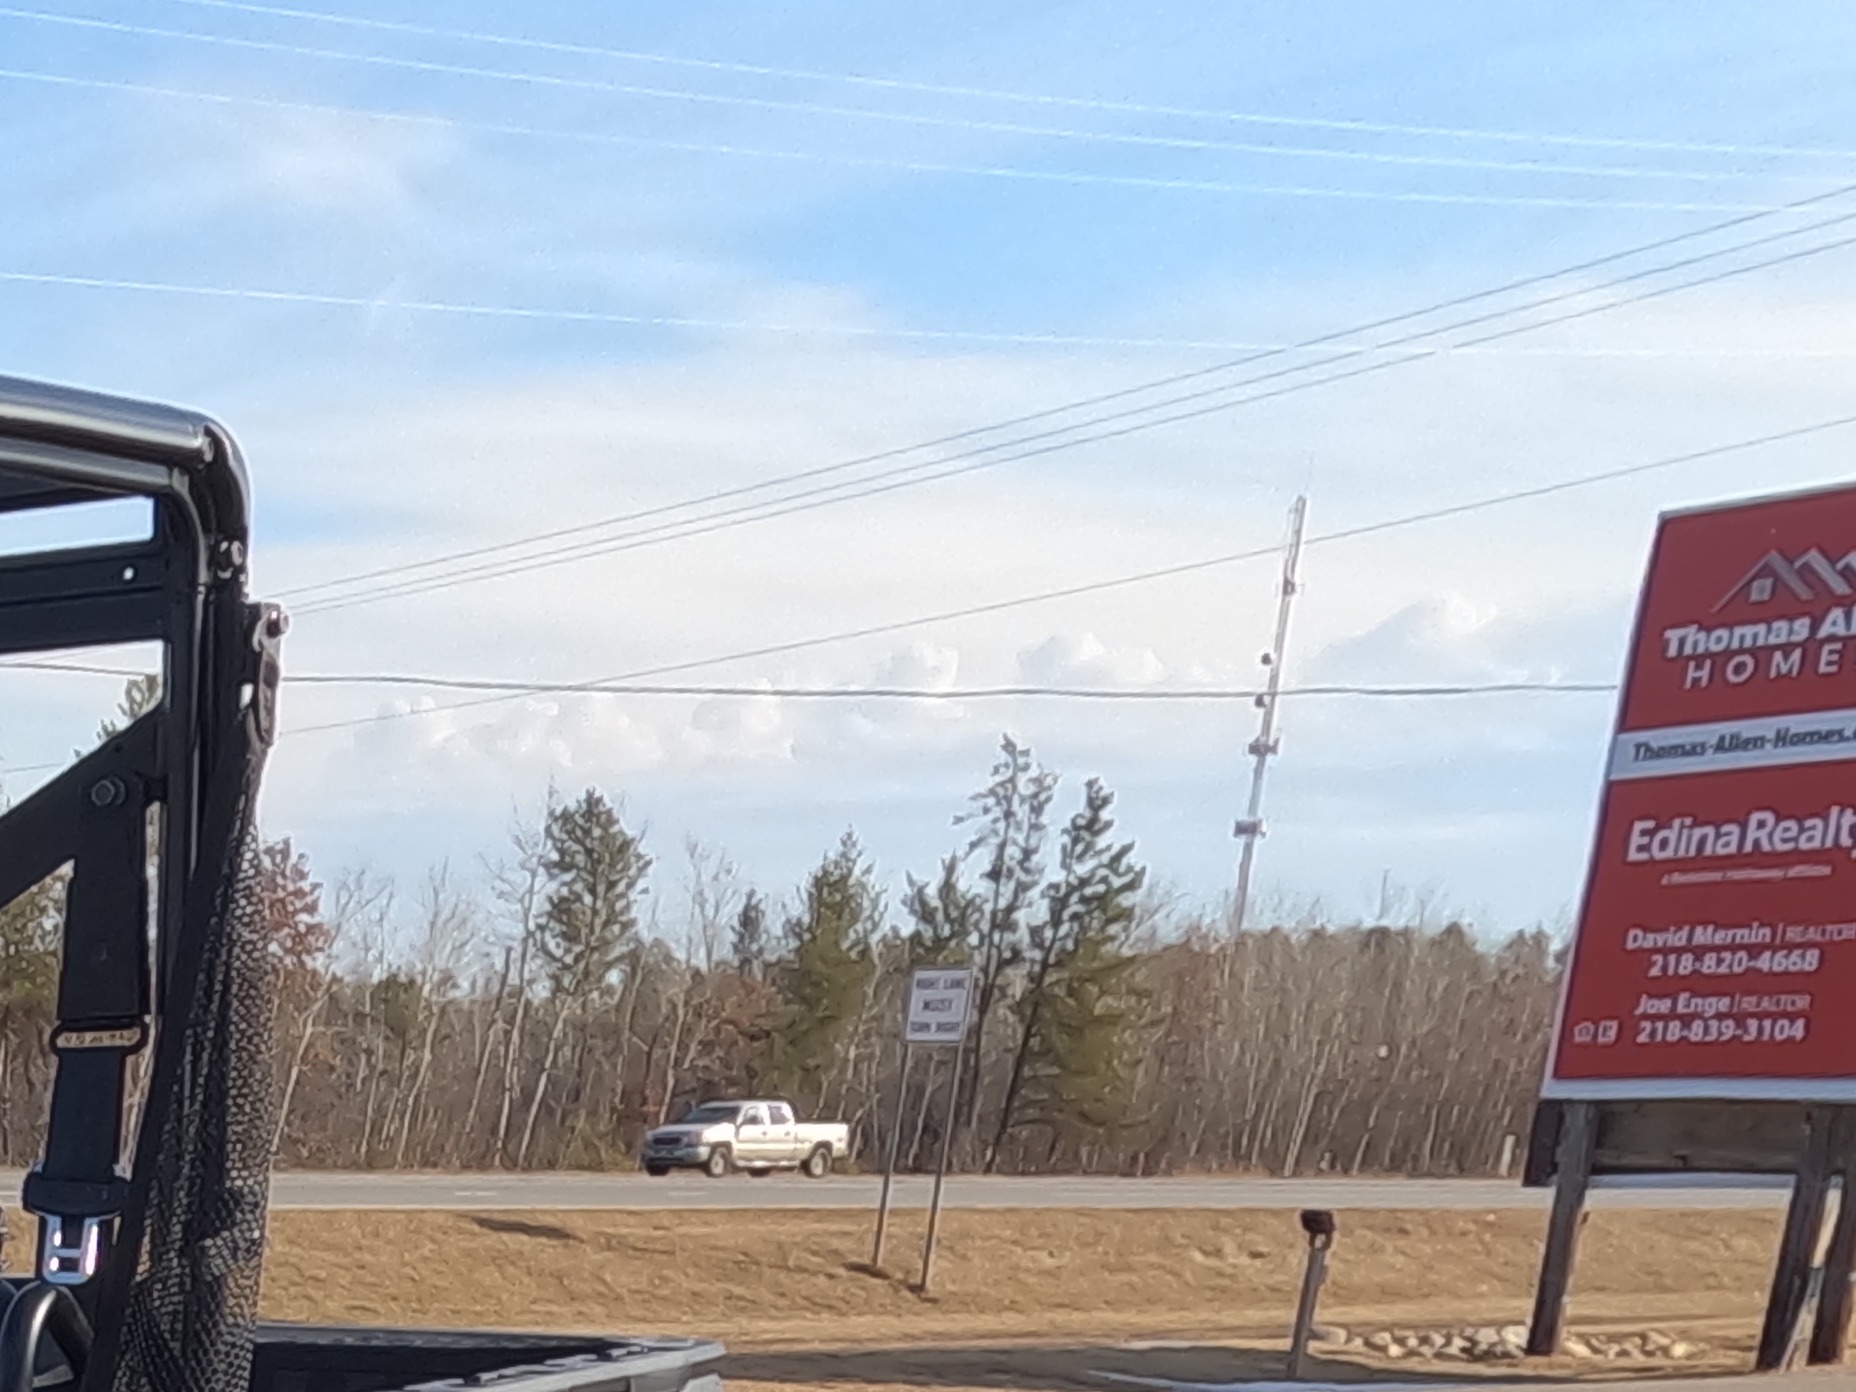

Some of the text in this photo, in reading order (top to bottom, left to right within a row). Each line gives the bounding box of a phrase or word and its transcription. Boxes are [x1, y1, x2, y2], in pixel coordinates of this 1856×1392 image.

[1663, 616, 1812, 658] Thomas
[1632, 727, 1856, 762] Thomas-Allen-Homes.
[1626, 804, 1856, 863] Edina Realt
[1626, 925, 1690, 950] David
[1692, 920, 1772, 946] Mernin
[1647, 948, 1821, 978] 218-820-4668
[1634, 994, 1670, 1016] Joe
[1676, 991, 1731, 1017] Enge
[1635, 1017, 1807, 1043] 218-839-3104
